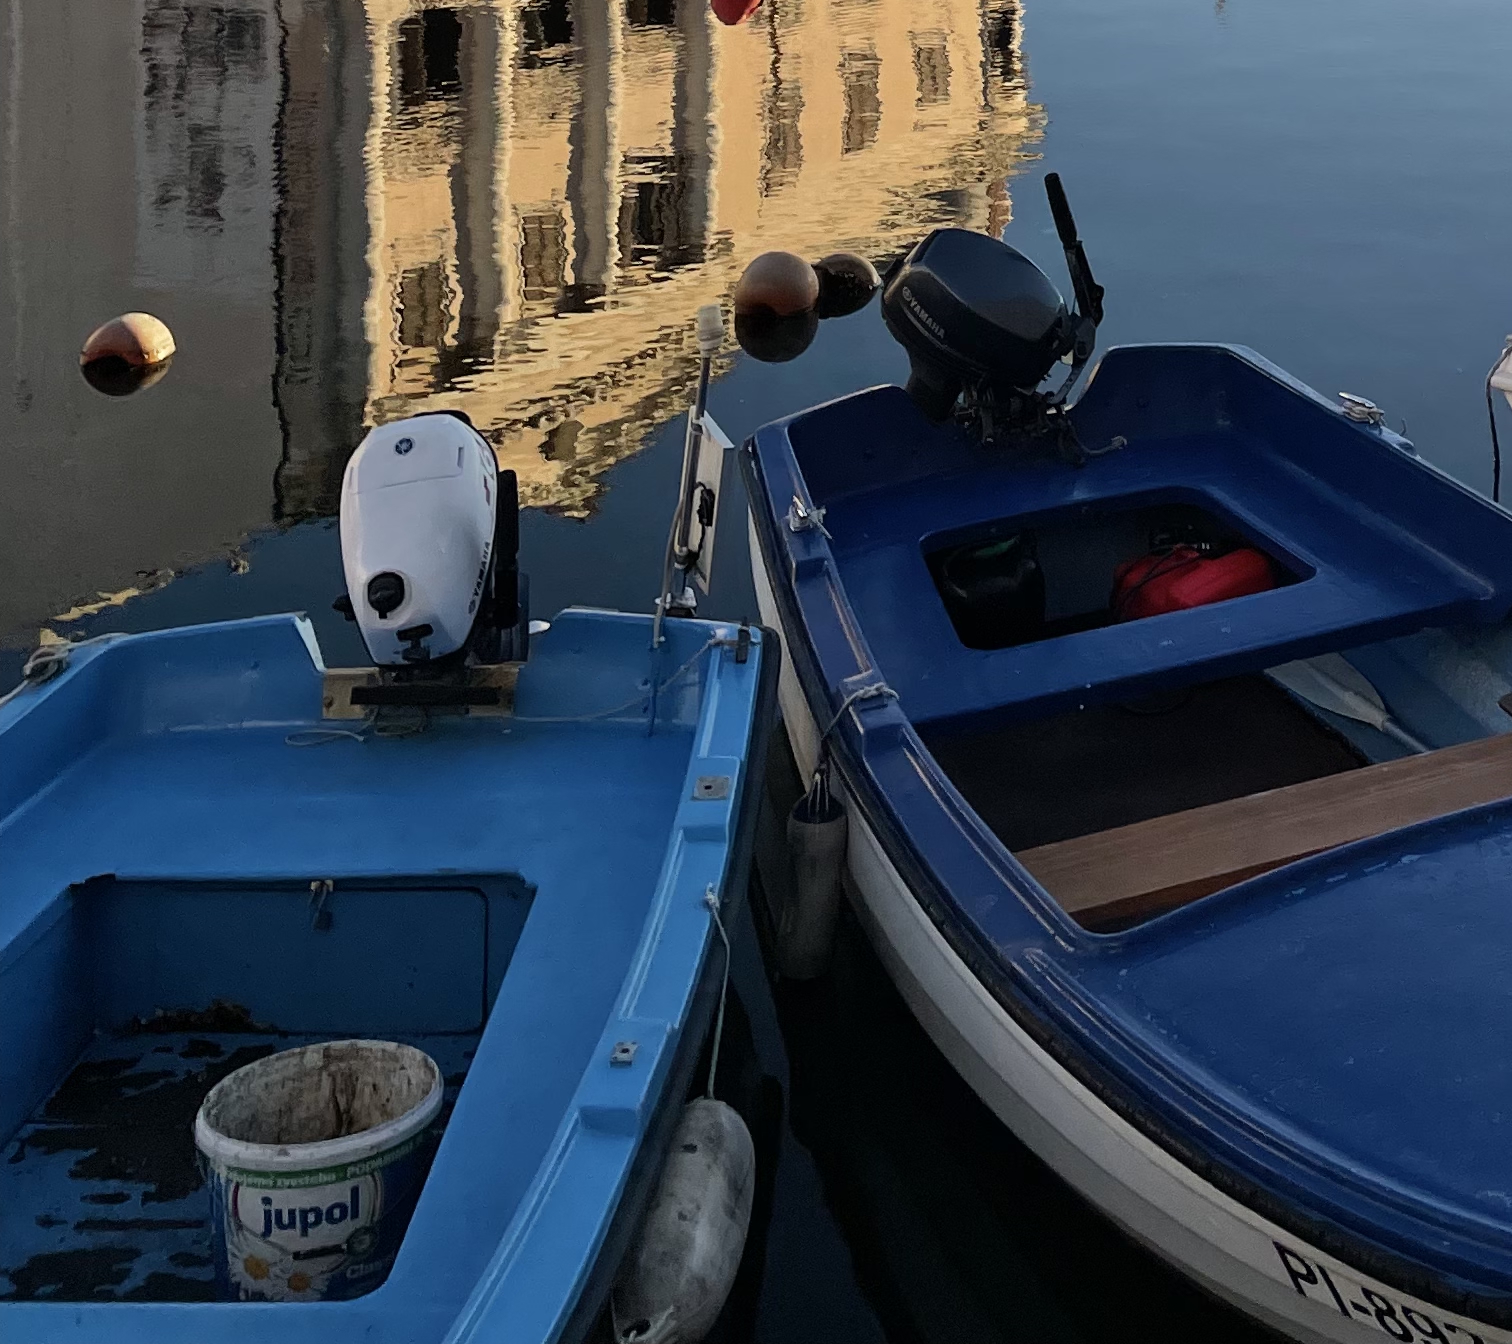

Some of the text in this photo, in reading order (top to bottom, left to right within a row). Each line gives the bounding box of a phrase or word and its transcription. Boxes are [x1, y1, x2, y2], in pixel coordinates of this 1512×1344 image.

[910, 297, 946, 339] YAMAHA
[472, 542, 491, 598] YAMAHA
[261, 1184, 360, 1238] jupol
